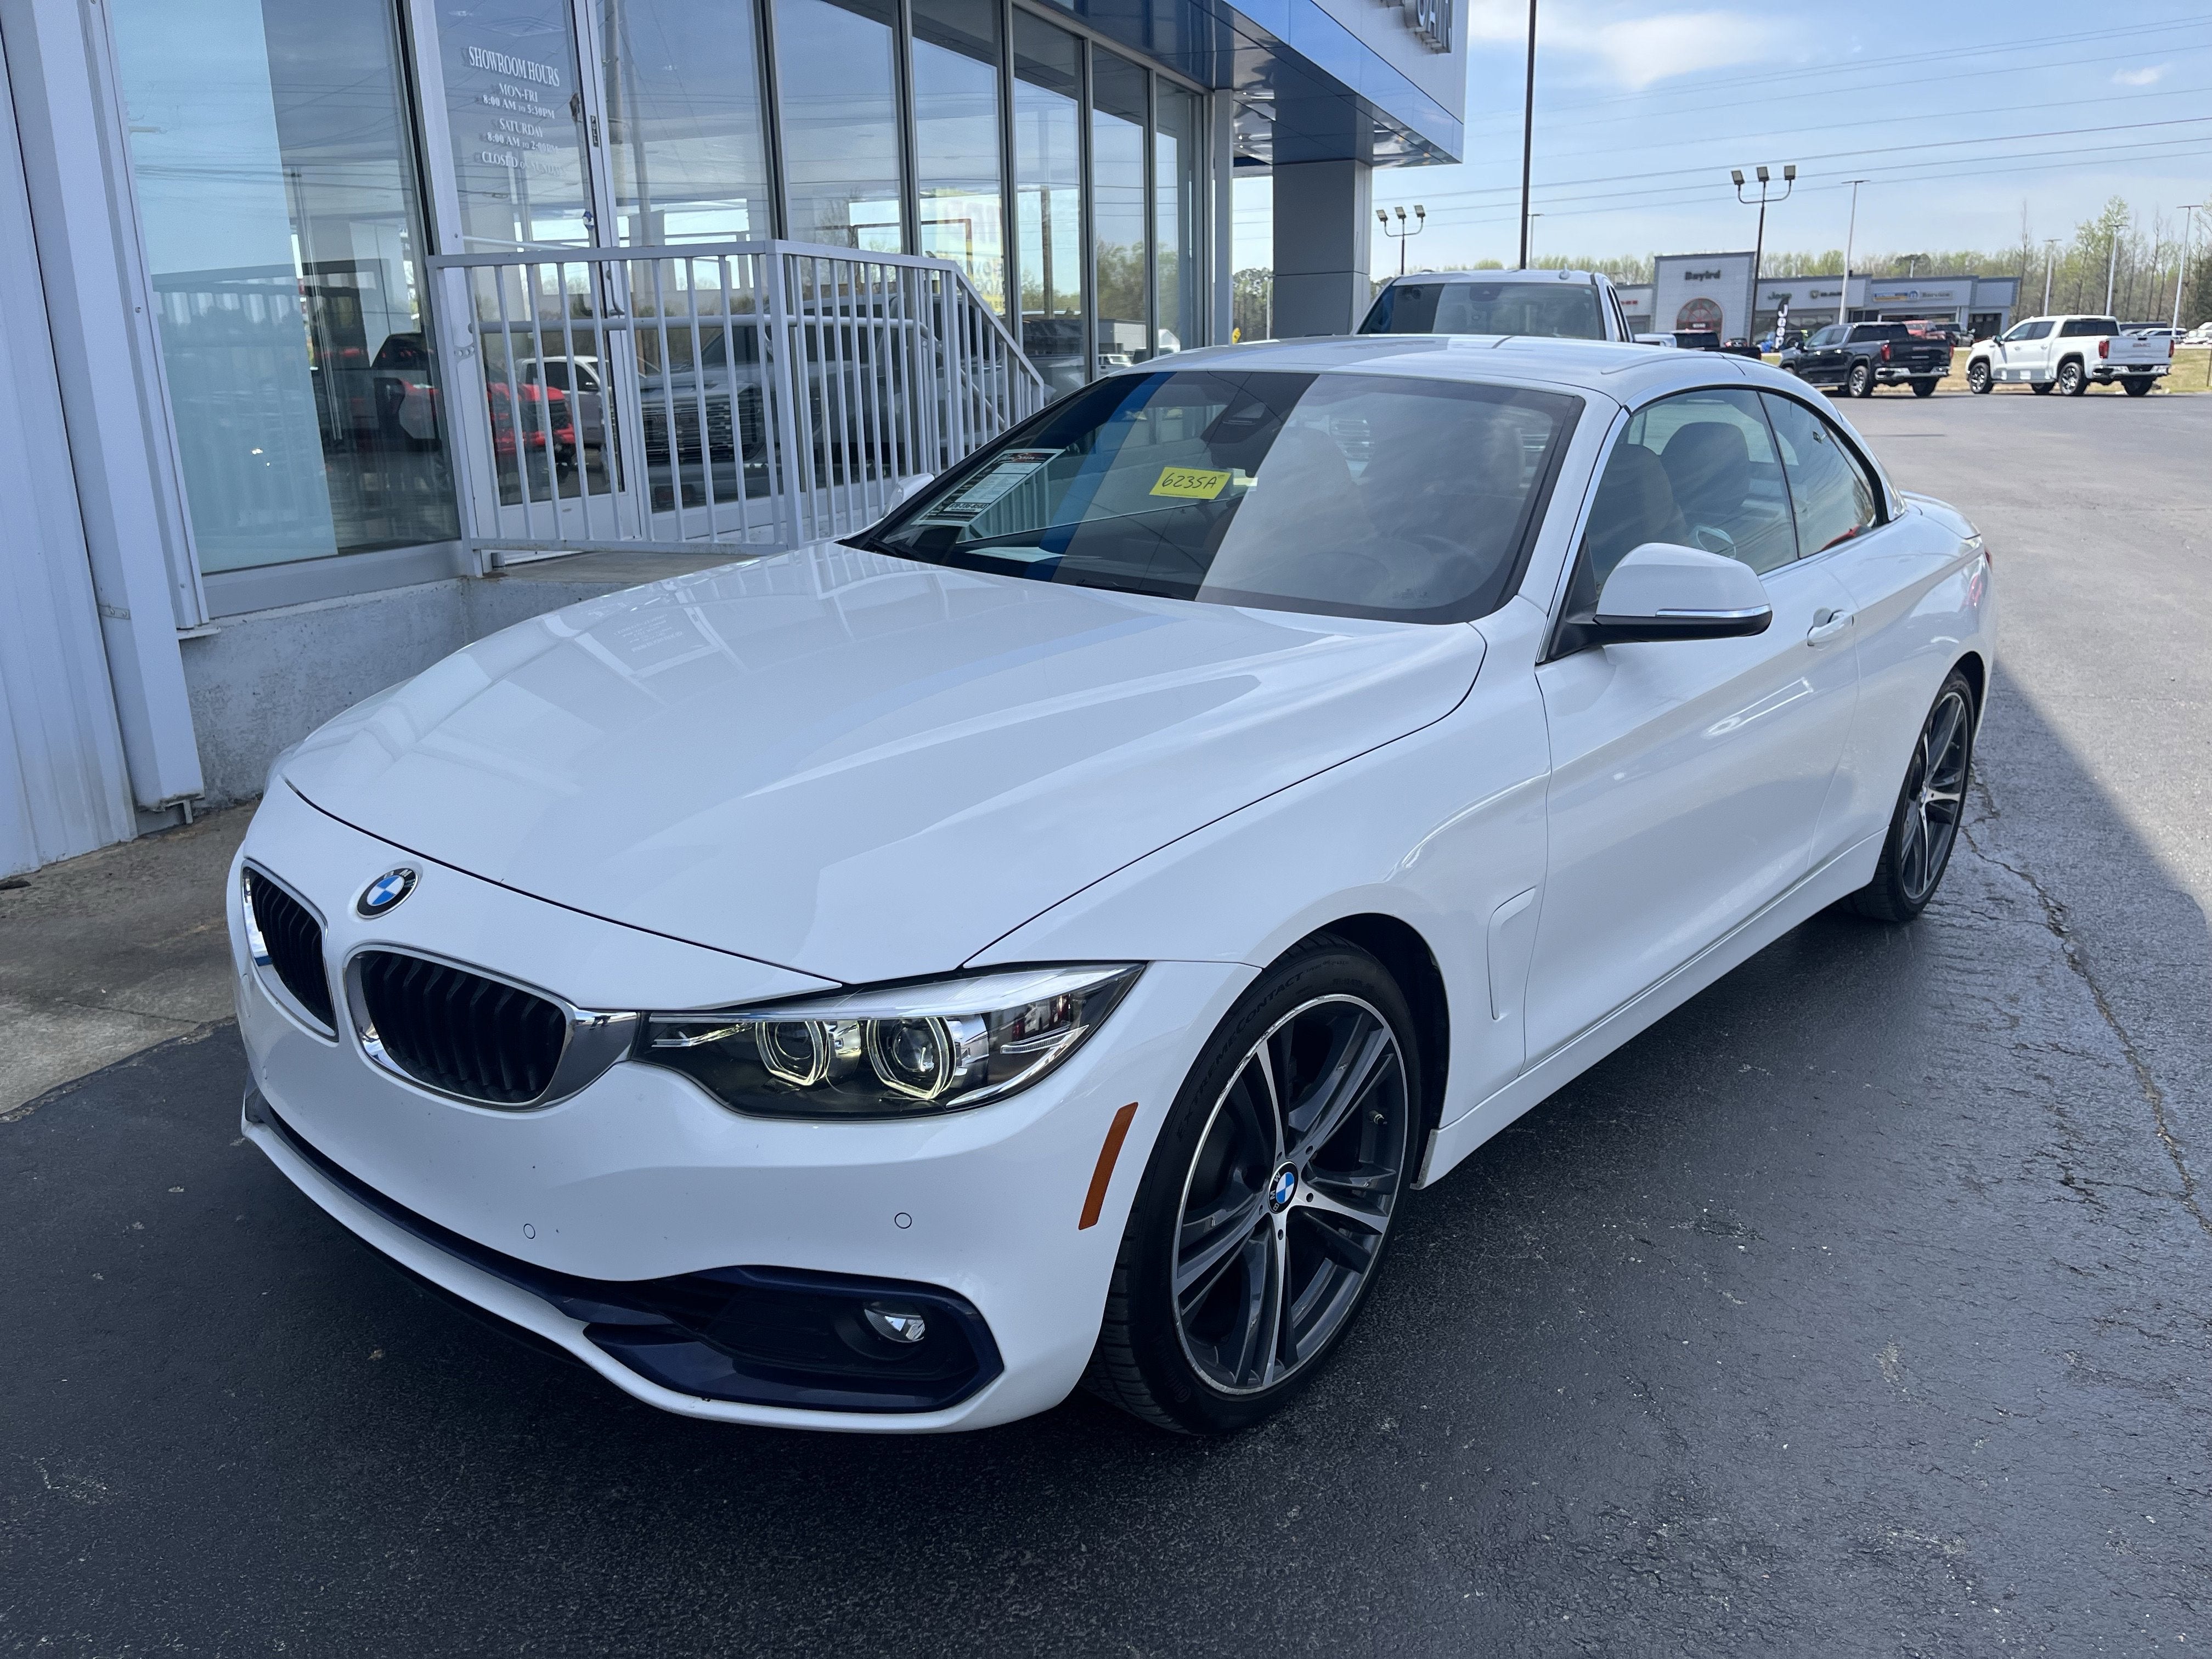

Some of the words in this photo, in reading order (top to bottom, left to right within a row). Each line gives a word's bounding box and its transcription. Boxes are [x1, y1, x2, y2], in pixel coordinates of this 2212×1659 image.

[468, 46, 527, 78] SHOWROOM
[527, 61, 560, 87] HOURS
[483, 94, 500, 106] 8:00
[502, 99, 517, 110] AM
[499, 82, 538, 103] MON-FRI
[499, 118, 543, 137] SATURDAY
[487, 132, 504, 144] 8:00
[506, 136, 520, 146] AM
[482, 151, 518, 167] CLOSED
[1775, 304, 1788, 349] Jeep
[1162, 472, 1217, 489] 6235A
[1269, 1172, 1281, 1211] BMW
